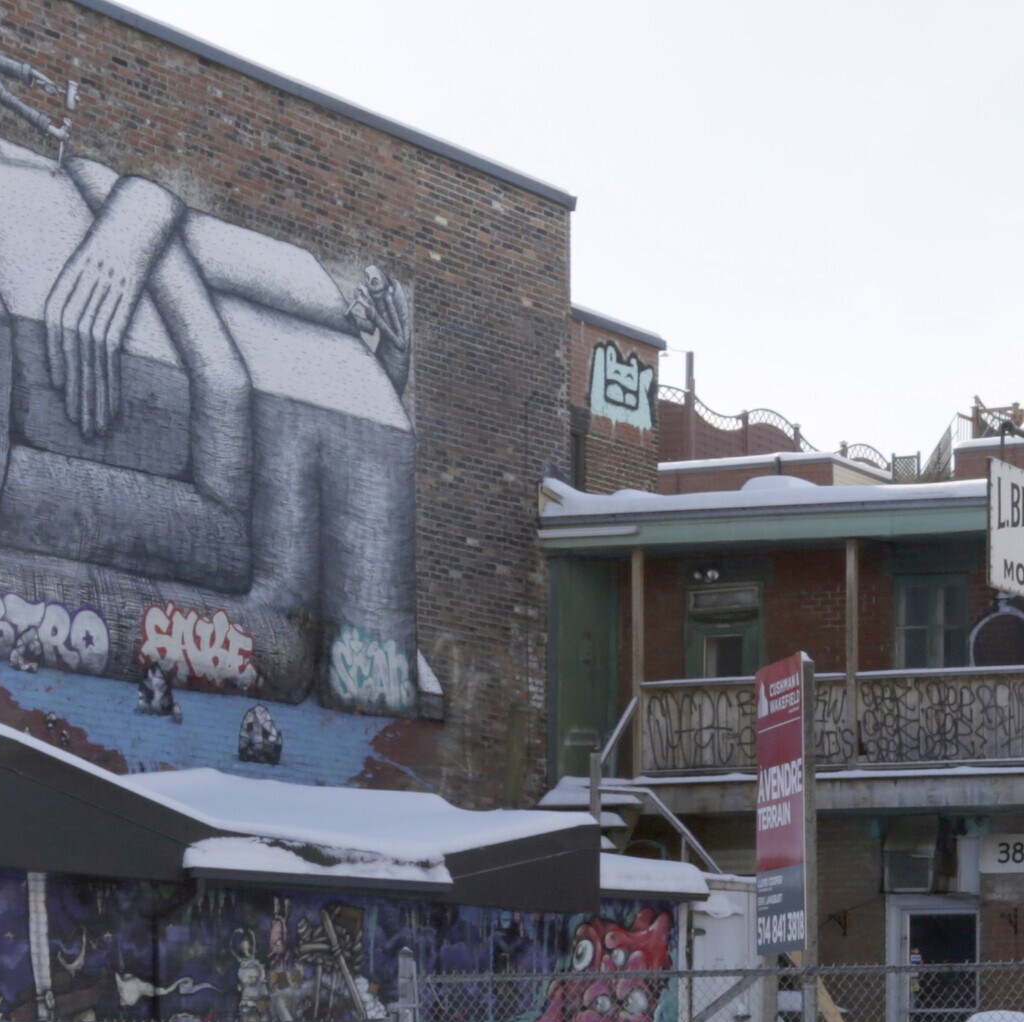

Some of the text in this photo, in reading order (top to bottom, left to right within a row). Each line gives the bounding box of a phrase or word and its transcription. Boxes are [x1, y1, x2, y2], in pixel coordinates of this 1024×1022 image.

[769, 674, 796, 697] CUSHMAN
[769, 689, 800, 714] WAKEFIELD
[764, 758, 803, 801] VENDRE
[758, 801, 792, 831] TERRAIN
[997, 842, 1024, 864] 38
[758, 916, 771, 946] 514
[772, 914, 787, 944] 841
